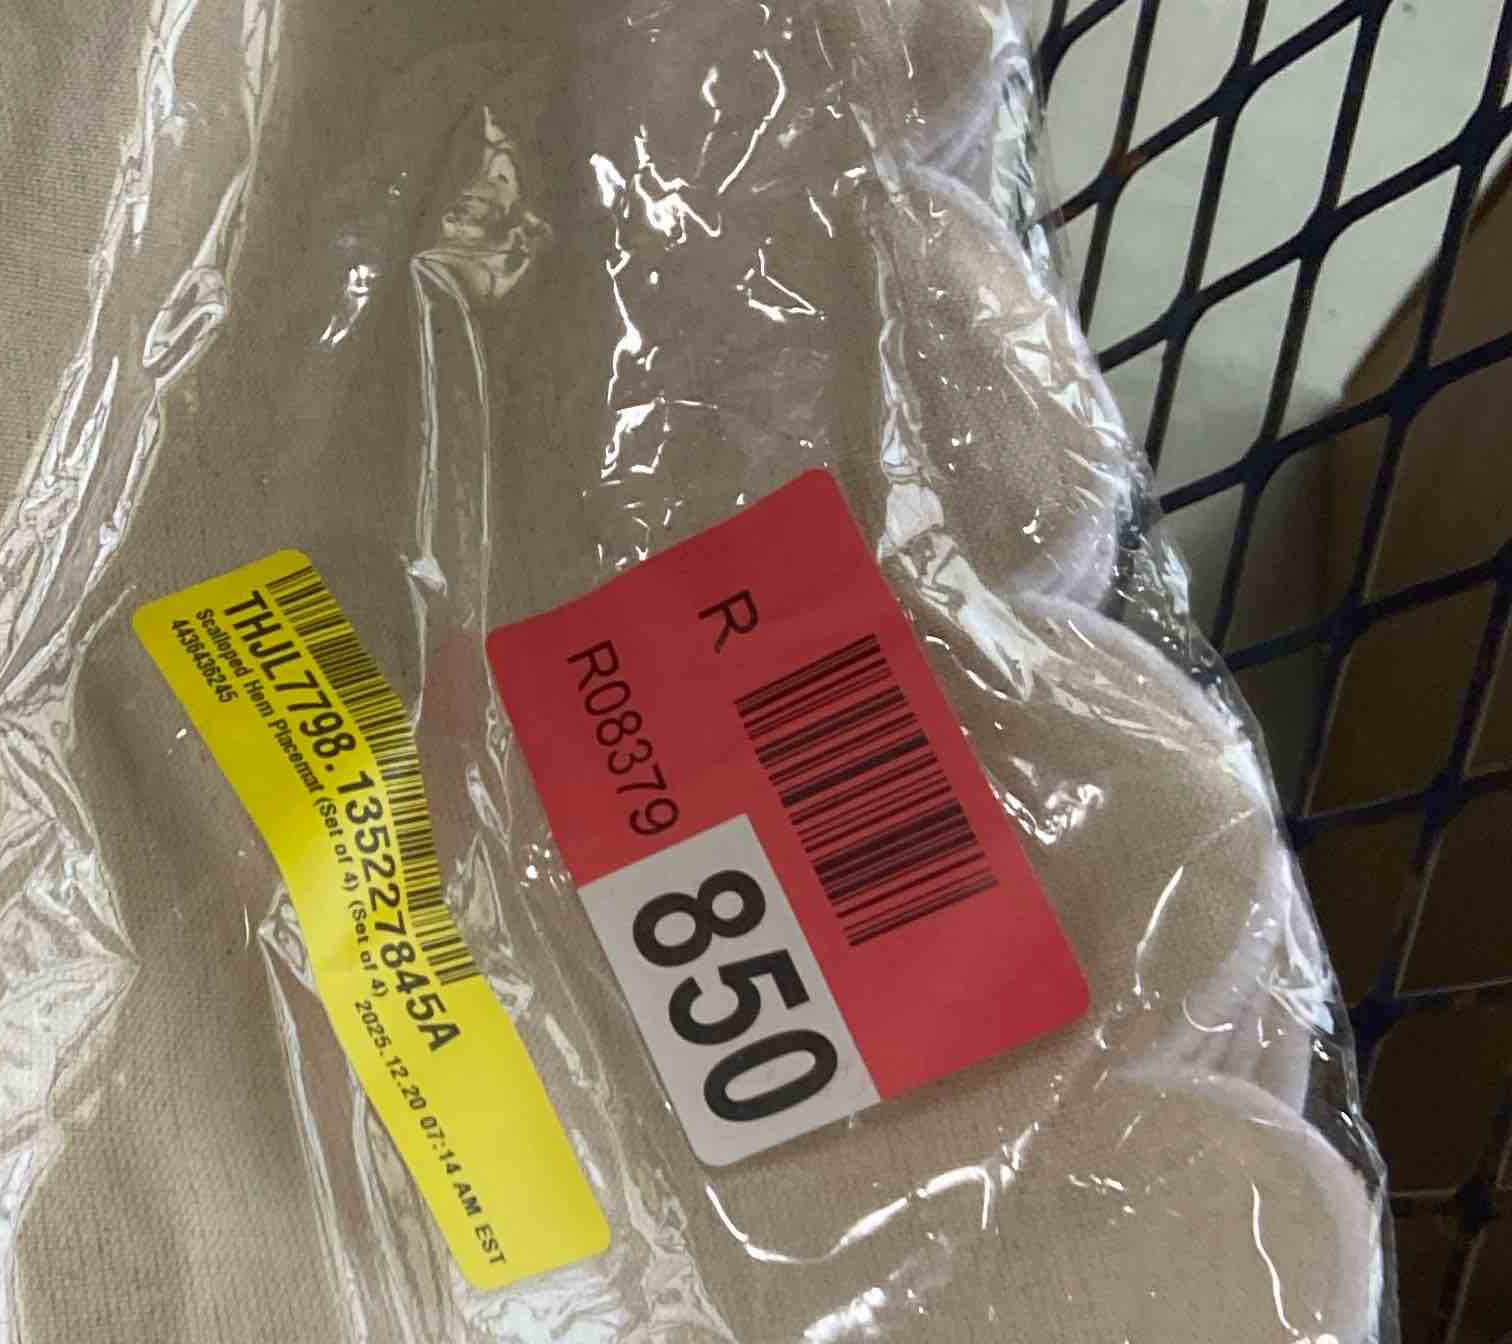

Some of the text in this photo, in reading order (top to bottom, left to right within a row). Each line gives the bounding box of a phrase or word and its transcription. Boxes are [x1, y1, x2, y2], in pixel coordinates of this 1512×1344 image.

[171, 619, 239, 703] 4436436245
[567, 640, 679, 835] R08379
[697, 589, 759, 654] R
[194, 607, 389, 998] Scalloped Hem Placemat (Set of 4) (Set of 4)
[225, 589, 461, 1053] THJL7798.135227845A
[632, 869, 838, 1123] 850
[355, 1000, 507, 1265] 2025.12.20 07:14 AM EST
